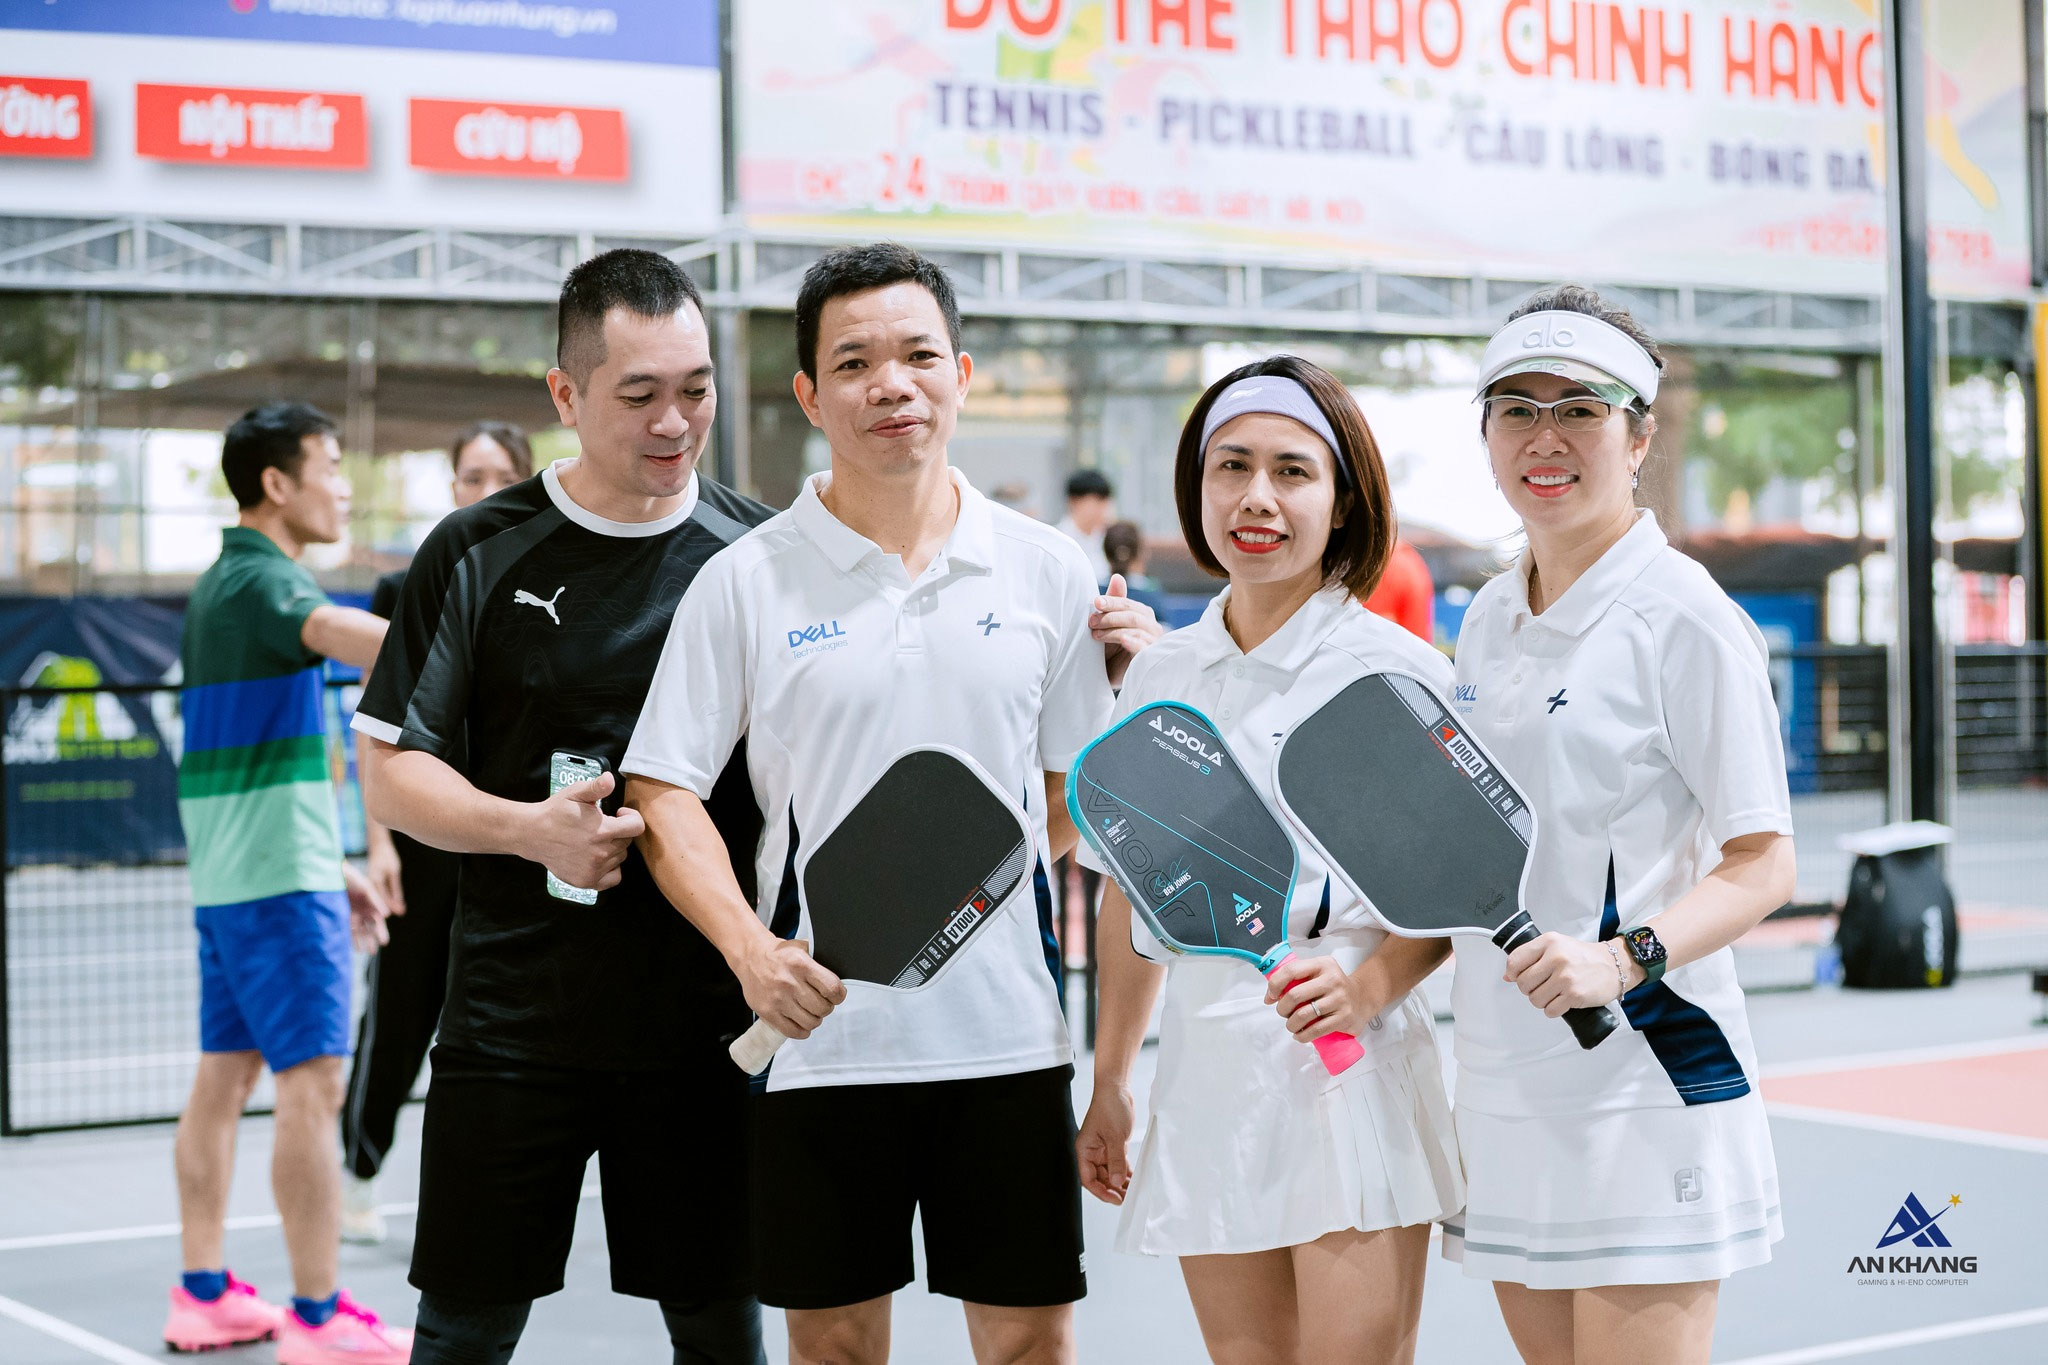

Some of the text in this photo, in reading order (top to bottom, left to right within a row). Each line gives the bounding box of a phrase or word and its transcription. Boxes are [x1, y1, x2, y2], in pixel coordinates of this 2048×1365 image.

[934, 82, 1104, 138] TENNIS
[1158, 96, 1416, 160] PICKLEBALL
[879, 152, 926, 202] 24
[788, 620, 846, 648] DELL
[792, 639, 849, 660] Technologies
[1163, 725, 1223, 767] JOOLA
[1449, 738, 1483, 775] JOOLA
[559, 770, 597, 786] 08:
[1163, 872, 1192, 896] BEN JOHNS
[946, 907, 977, 940] JOOLA
[1235, 902, 1262, 926] JOOLA
